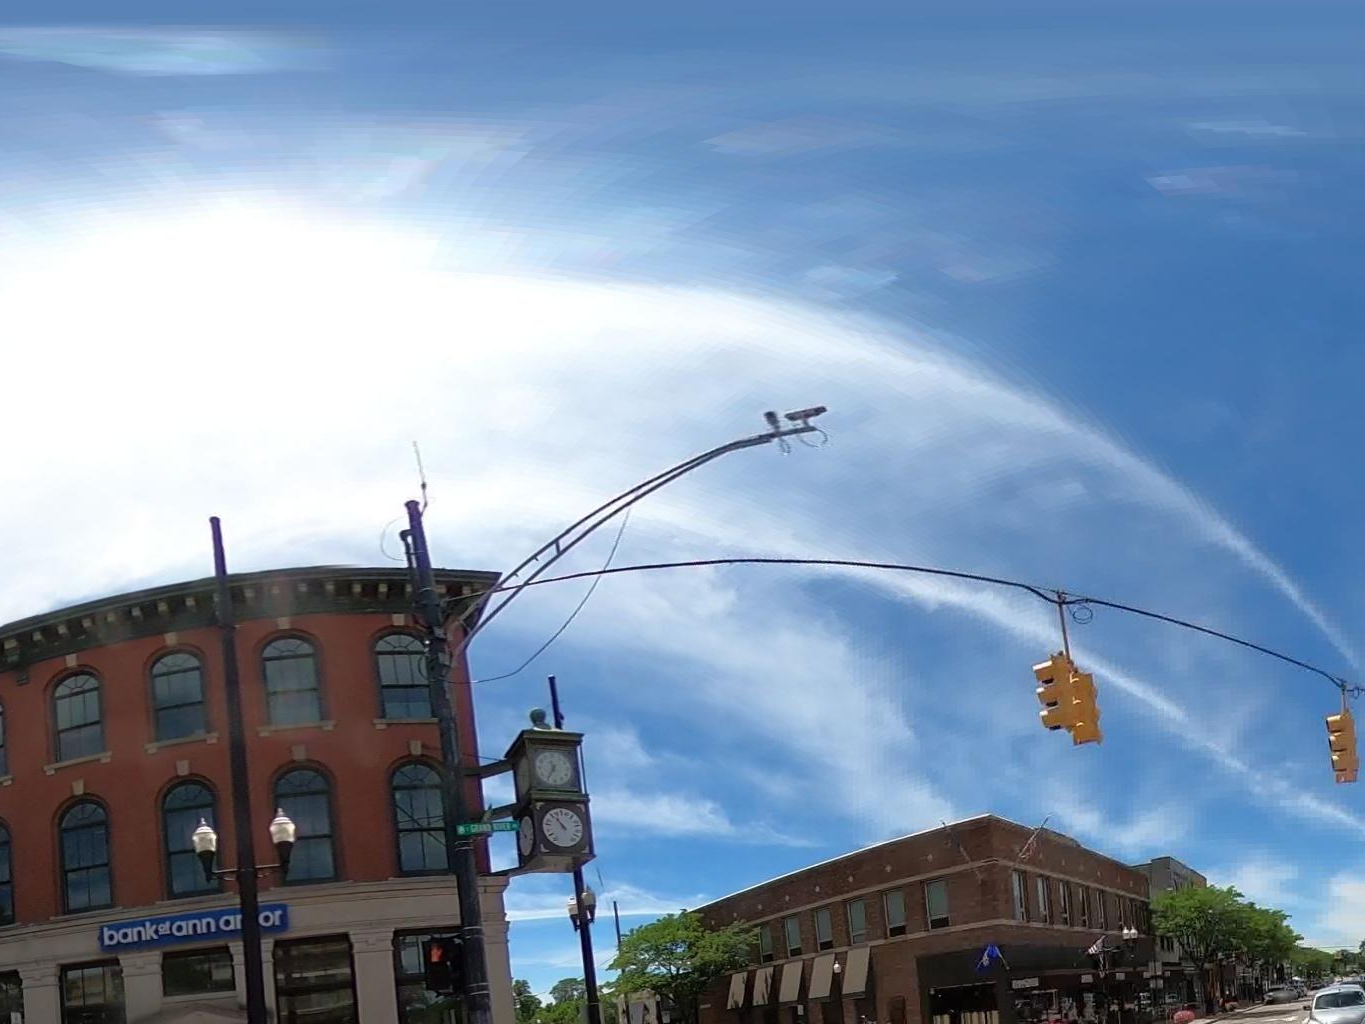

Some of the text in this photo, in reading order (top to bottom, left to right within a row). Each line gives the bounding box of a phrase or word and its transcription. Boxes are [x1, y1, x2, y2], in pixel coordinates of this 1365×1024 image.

[103, 910, 283, 946] bank of ann aror
